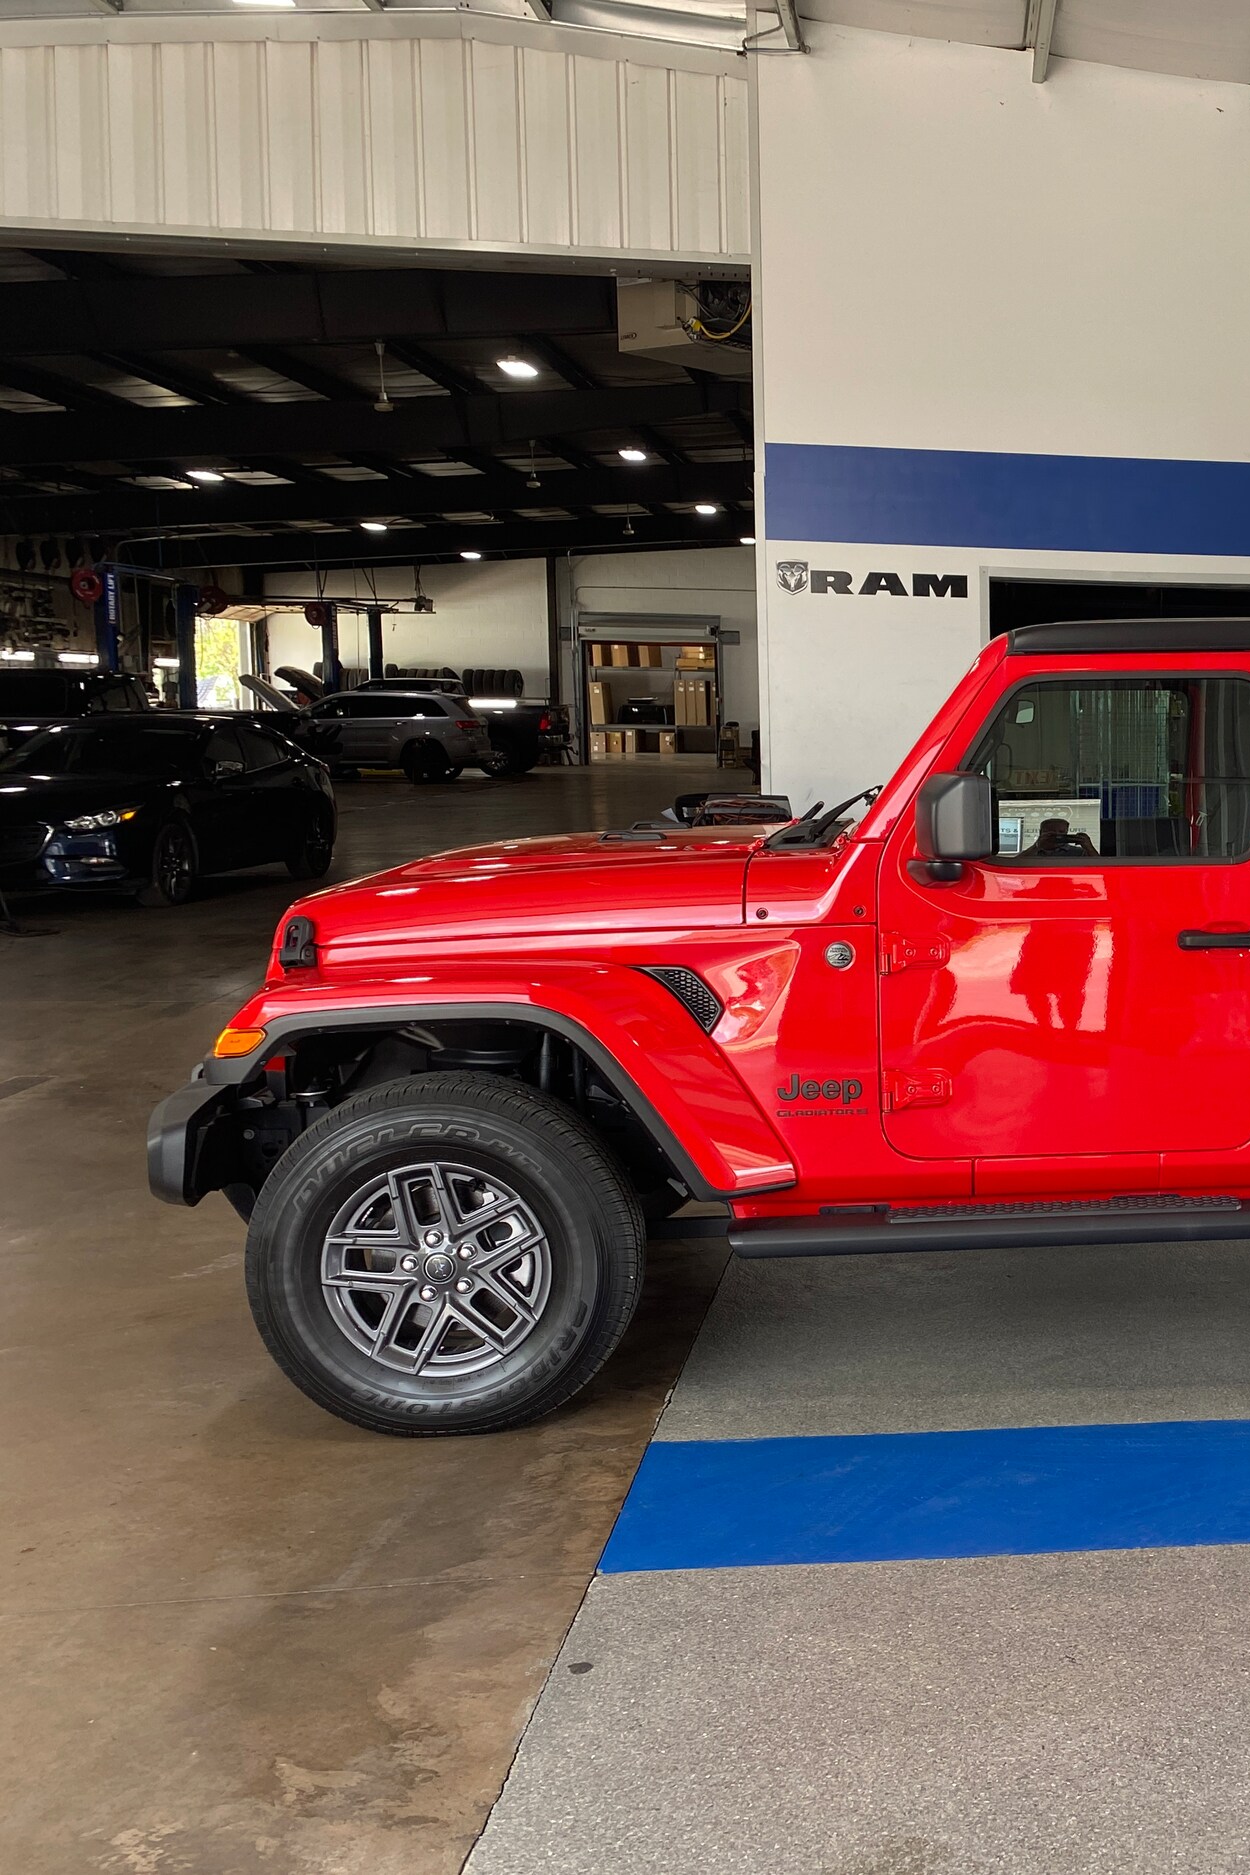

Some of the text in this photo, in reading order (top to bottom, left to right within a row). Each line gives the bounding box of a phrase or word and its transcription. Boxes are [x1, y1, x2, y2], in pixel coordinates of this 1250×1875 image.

[810, 569, 969, 598] RAM
[776, 1073, 862, 1105] Jeep
[776, 1108, 855, 1118] GLADIATOR
